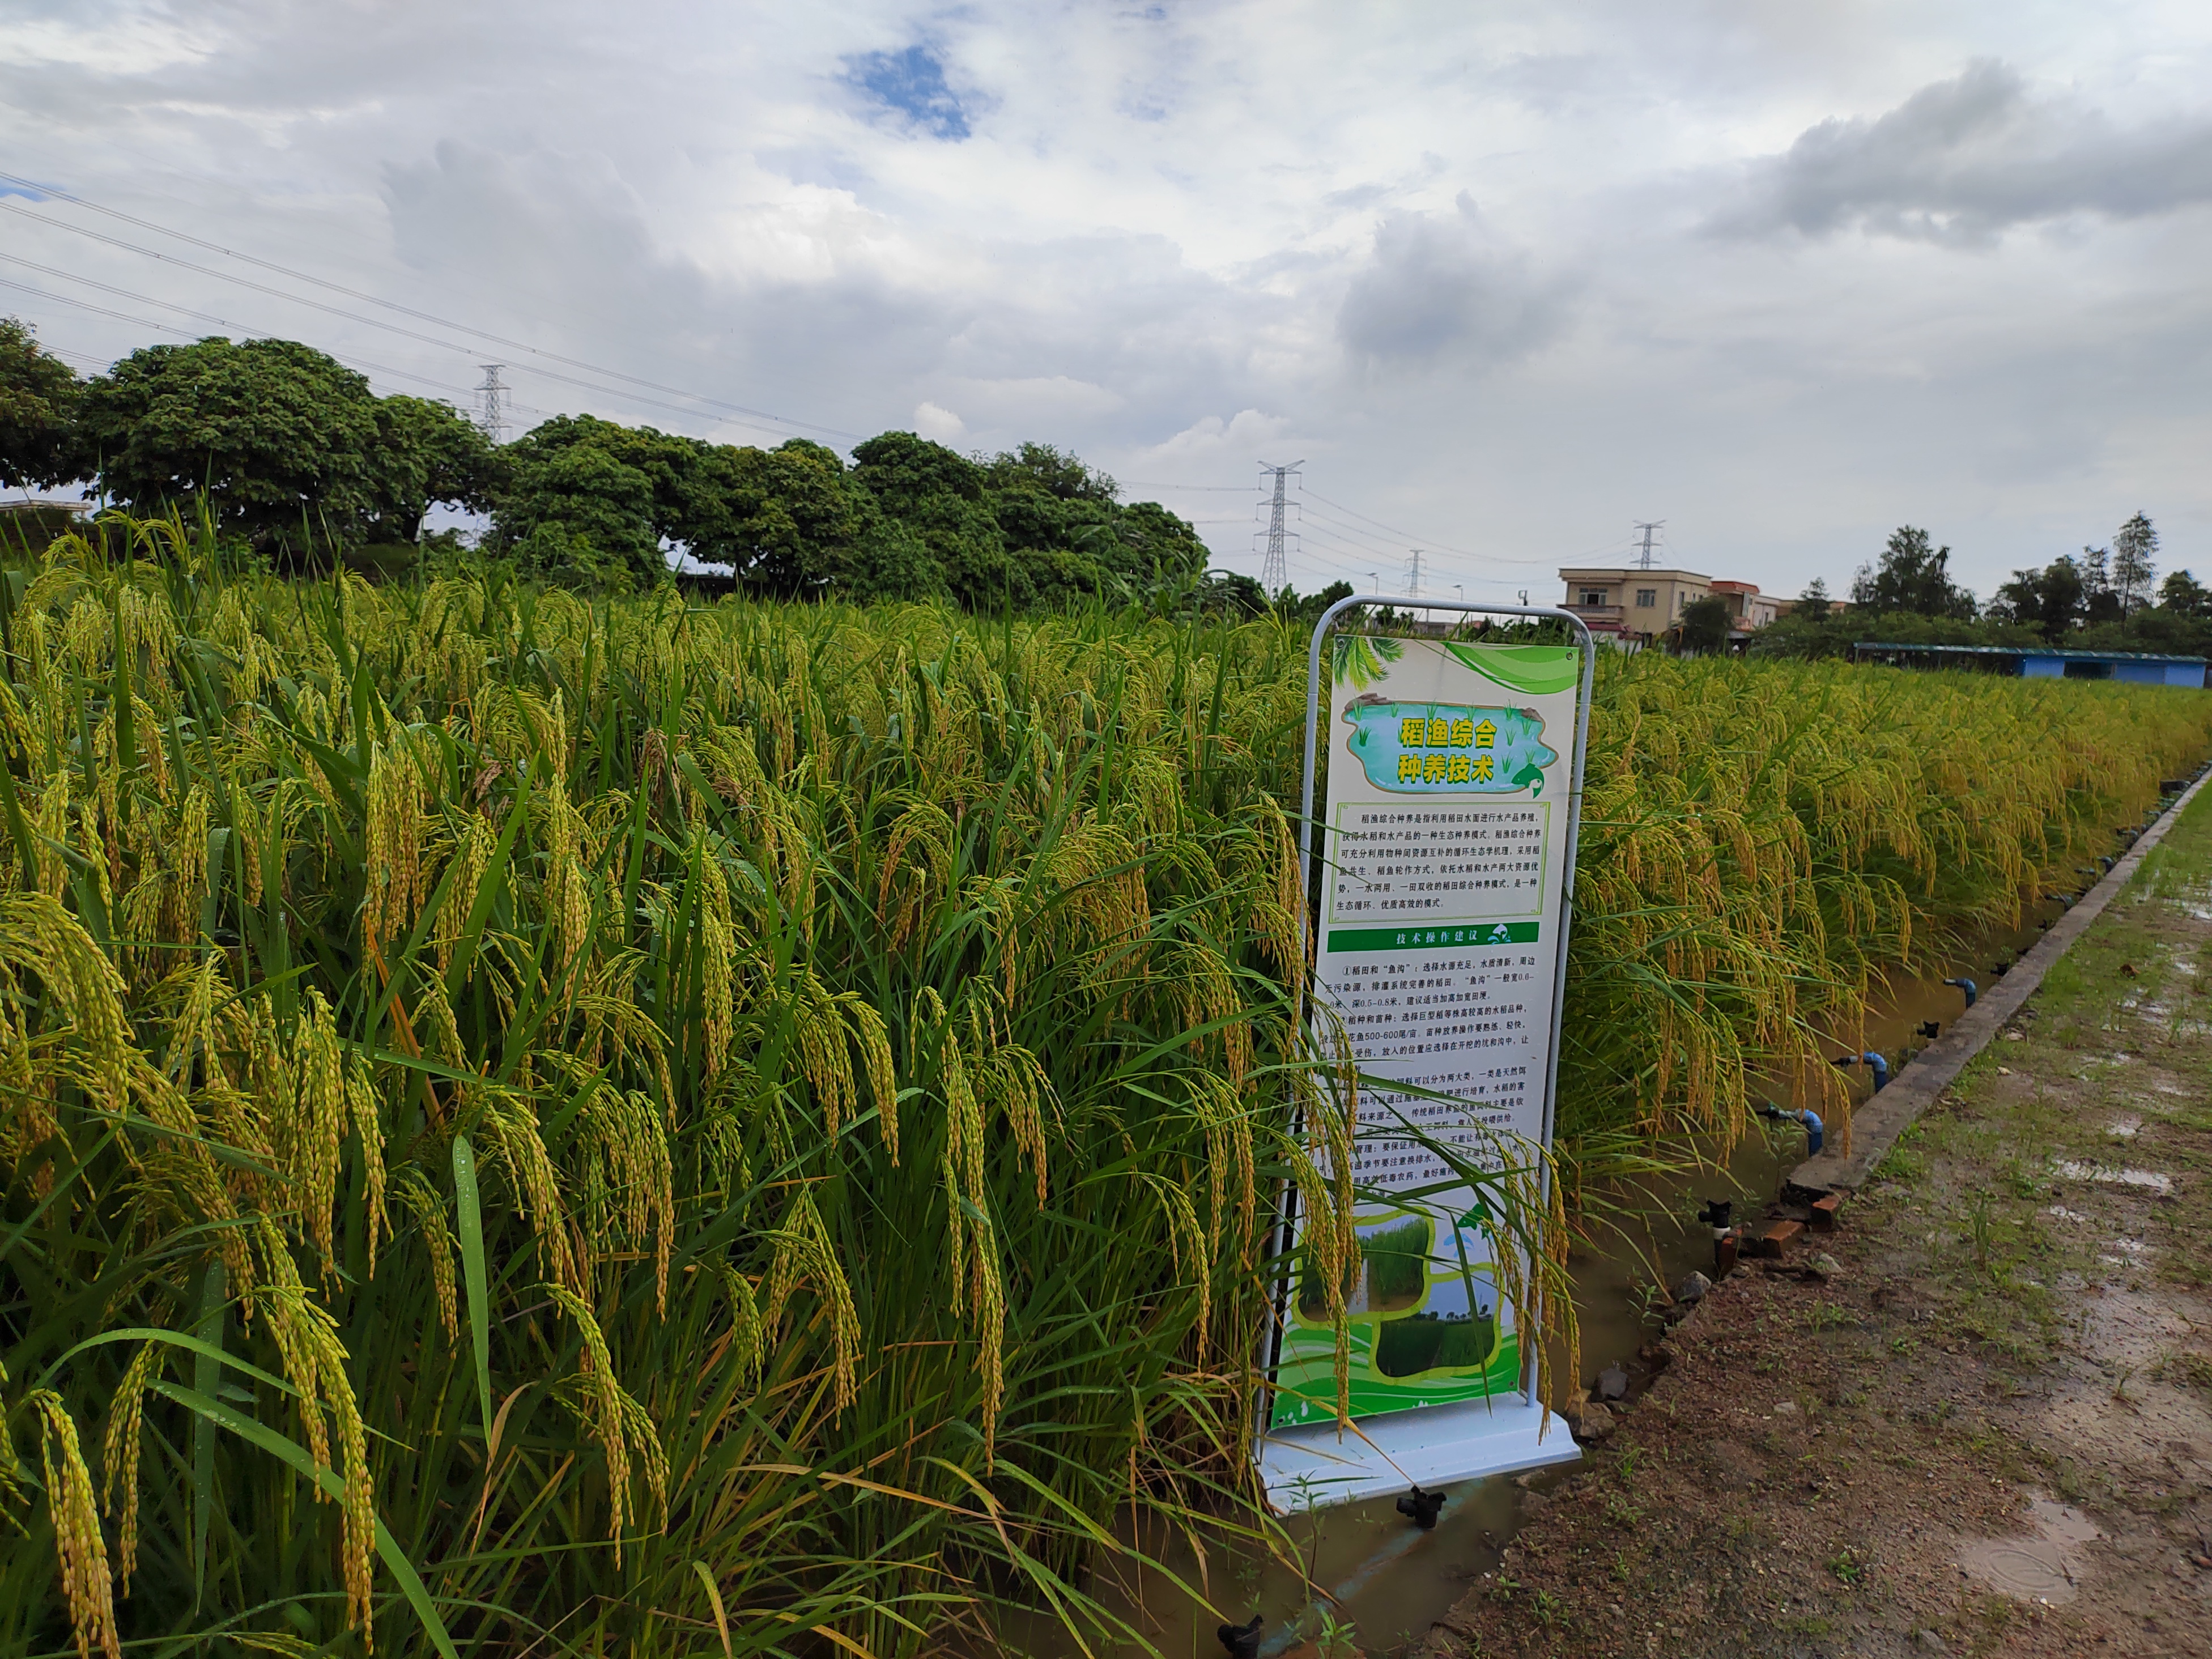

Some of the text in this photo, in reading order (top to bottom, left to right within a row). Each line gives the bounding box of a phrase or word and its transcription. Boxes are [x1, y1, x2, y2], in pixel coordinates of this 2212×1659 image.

[1401, 718, 1497, 748] 稻渔综合
[1398, 754, 1494, 784] 种养技术
[1336, 899, 1444, 911] 生态循环、优质高效的模式。
[1396, 930, 1477, 945] 技术操作建议
